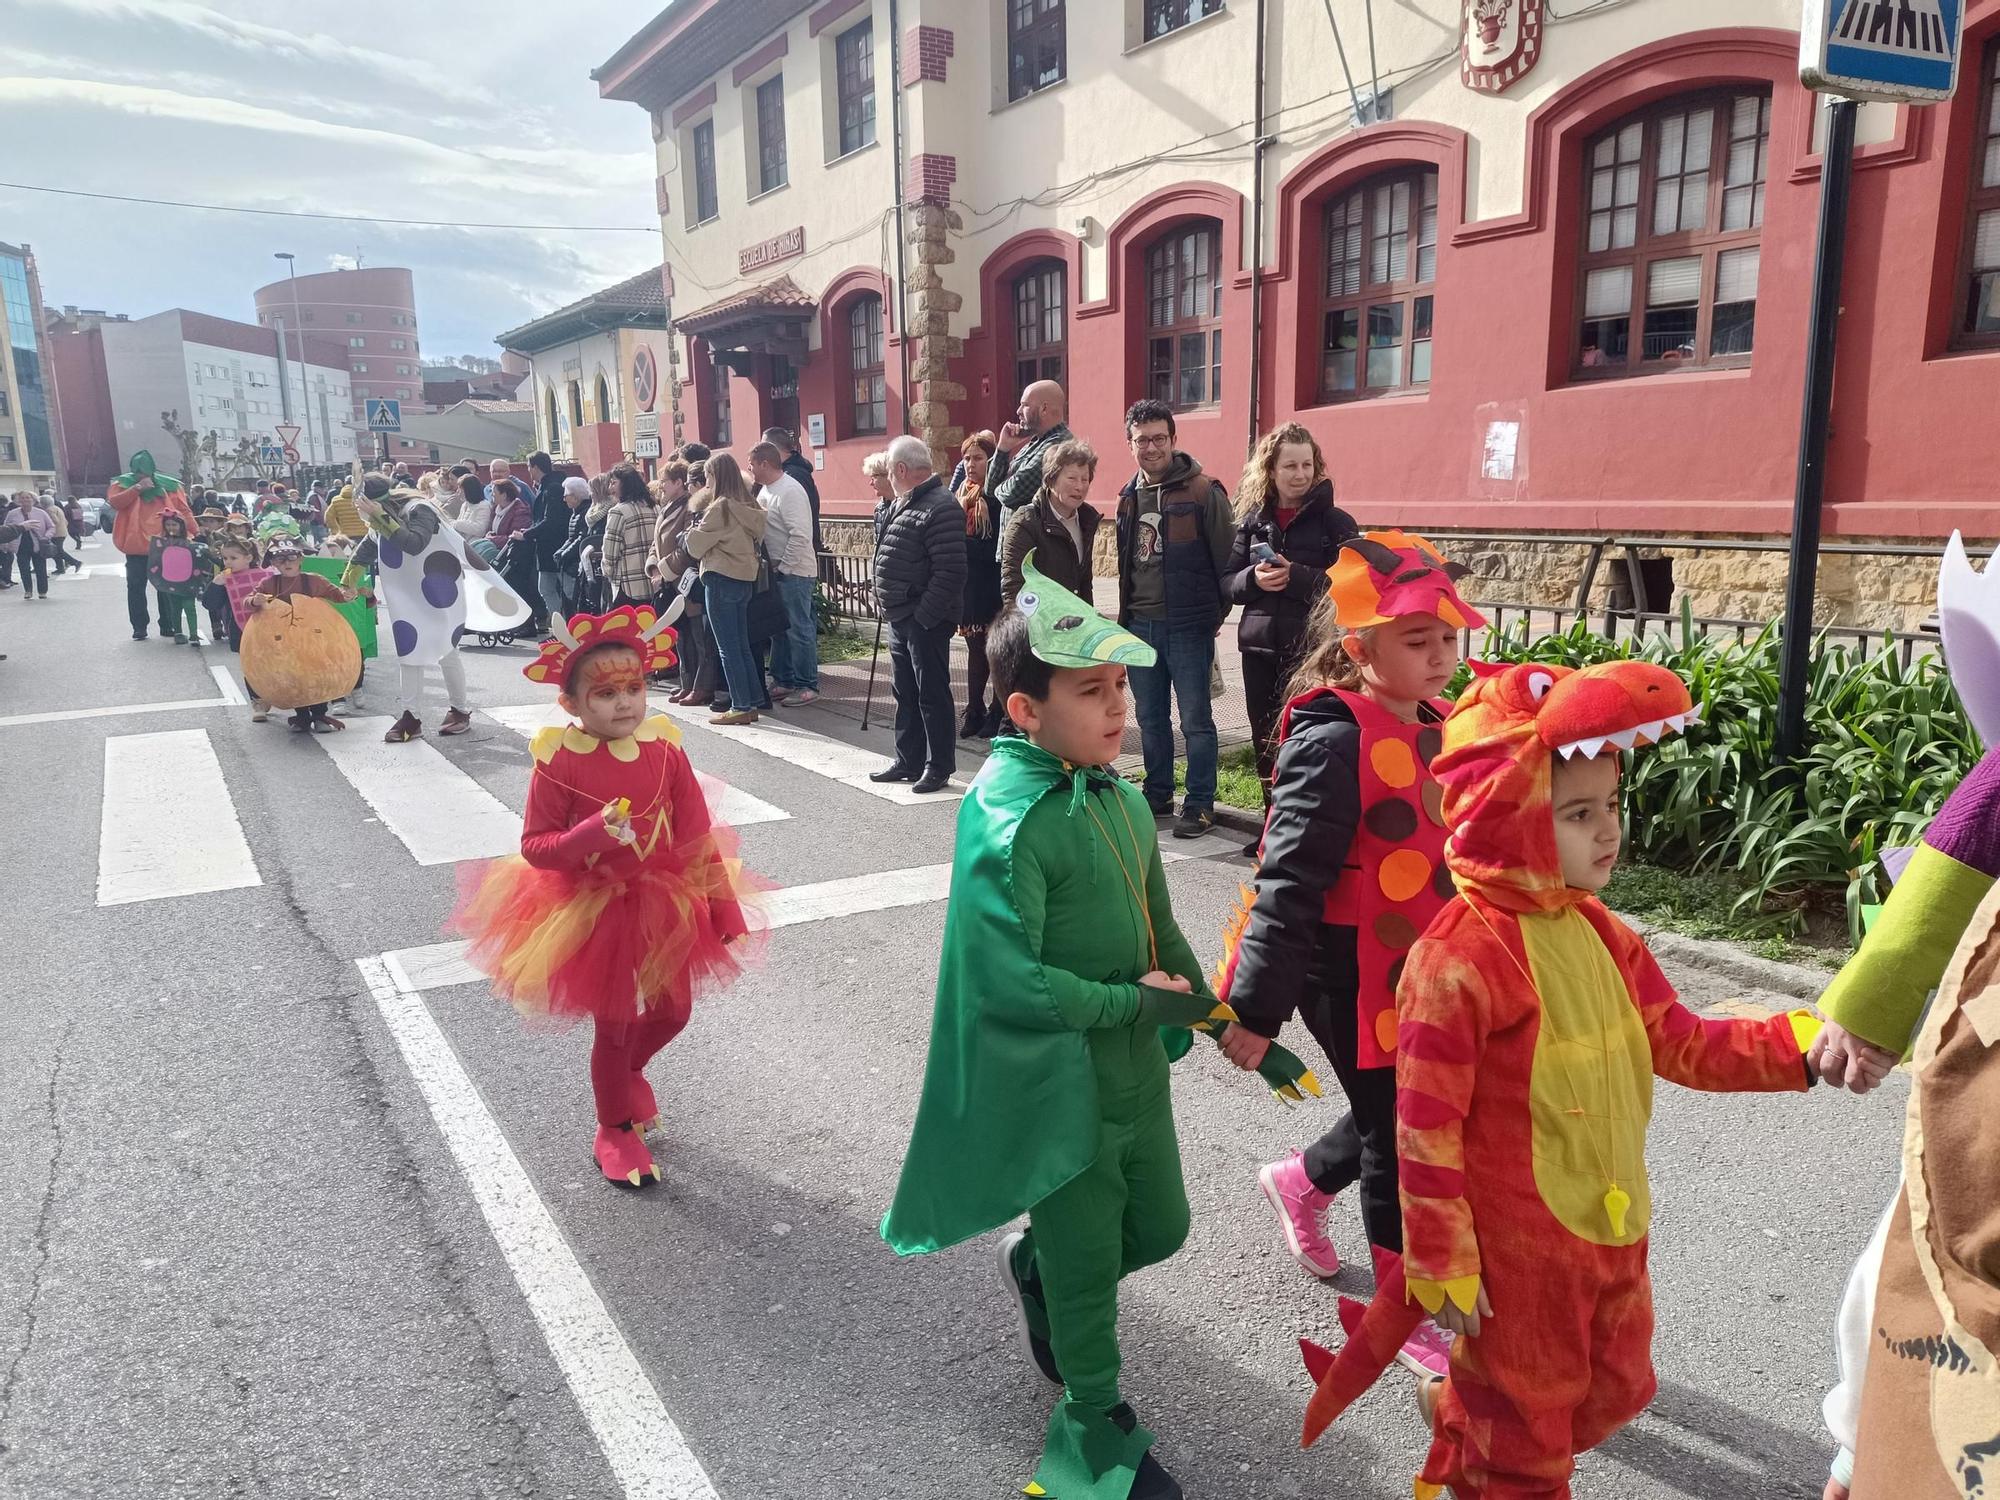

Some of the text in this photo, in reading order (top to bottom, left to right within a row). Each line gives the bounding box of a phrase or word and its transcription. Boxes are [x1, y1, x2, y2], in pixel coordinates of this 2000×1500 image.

[740, 232, 800, 269] ESCUELA DE NIÑAS
